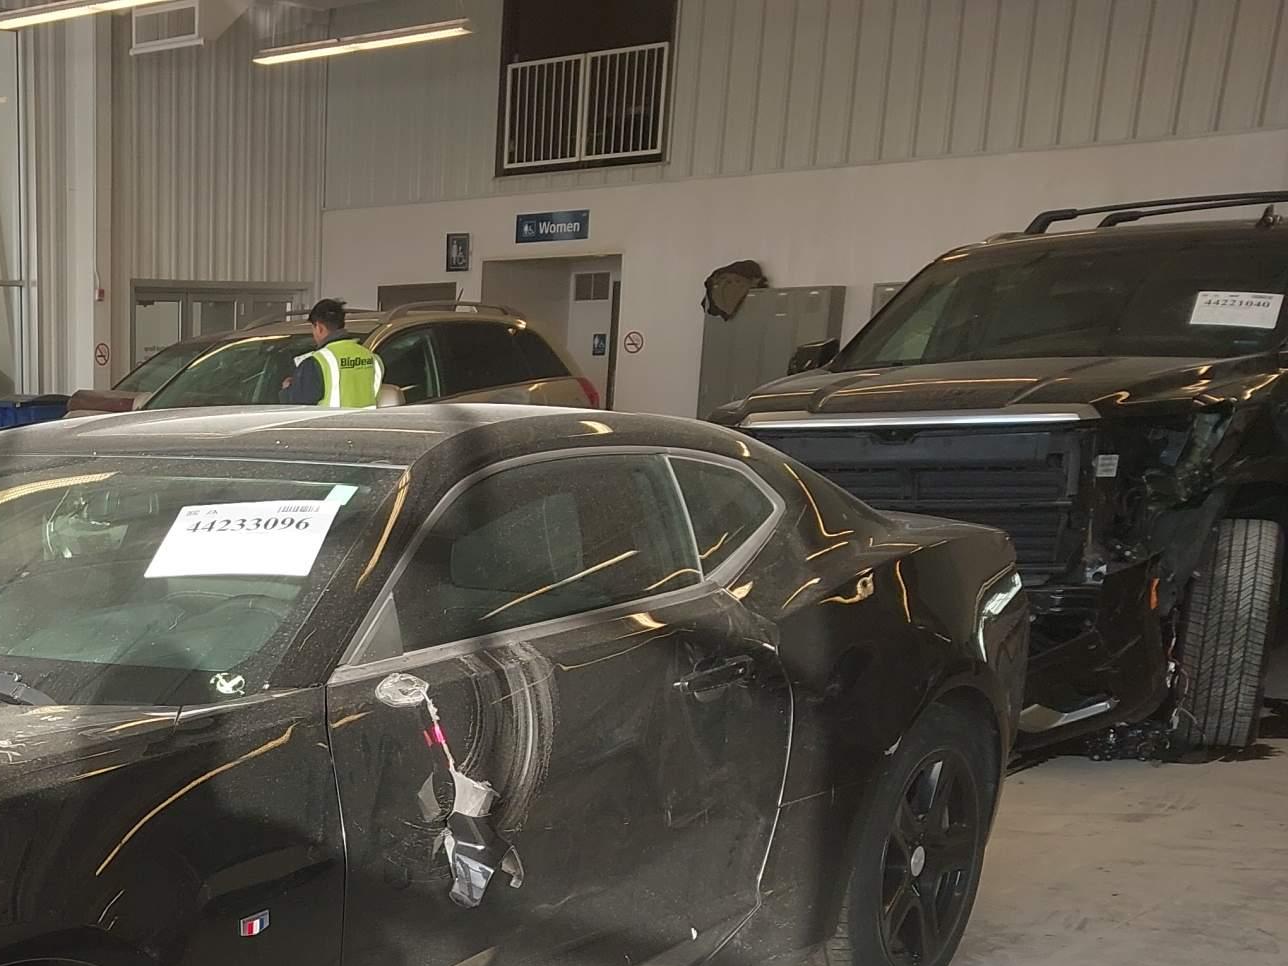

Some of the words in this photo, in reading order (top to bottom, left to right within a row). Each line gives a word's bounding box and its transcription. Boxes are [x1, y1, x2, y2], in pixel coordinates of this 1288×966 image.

[538, 221, 581, 235] Women
[1204, 298, 1271, 308] 44221040
[186, 516, 313, 533] 44233096
